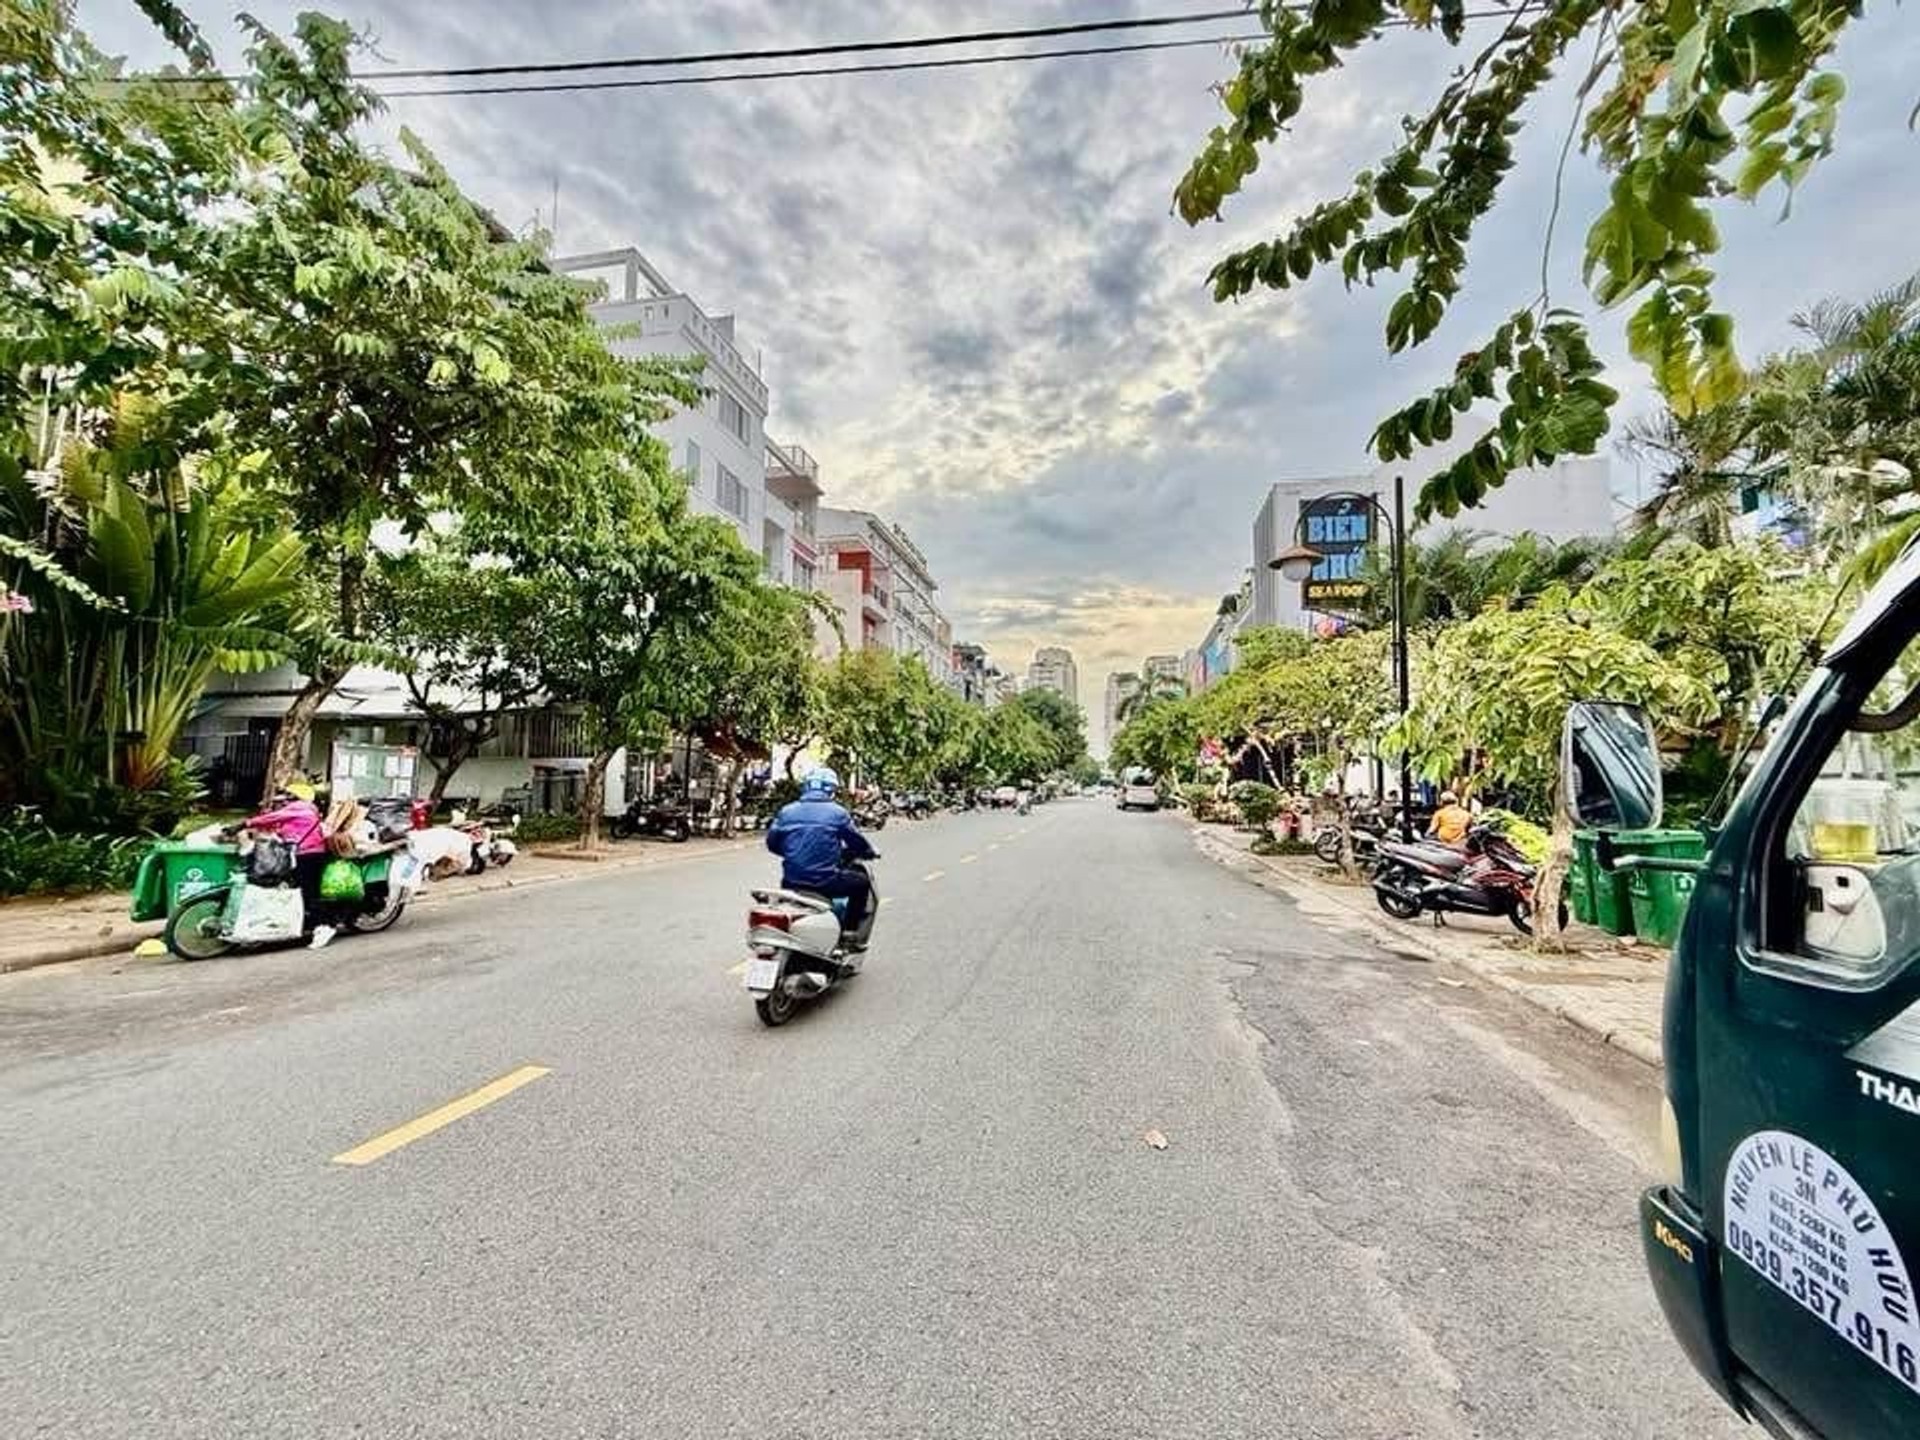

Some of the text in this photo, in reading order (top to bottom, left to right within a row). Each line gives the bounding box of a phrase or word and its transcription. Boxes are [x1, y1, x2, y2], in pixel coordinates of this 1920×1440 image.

[1856, 1070, 1920, 1114] THA
[1794, 1176, 1817, 1206] 3N
[1830, 1229, 1847, 1252] KG
[1830, 1250, 1848, 1274] KG
[1832, 1271, 1850, 1297] KG
[1729, 1220, 1918, 1386] 0939.357.916
